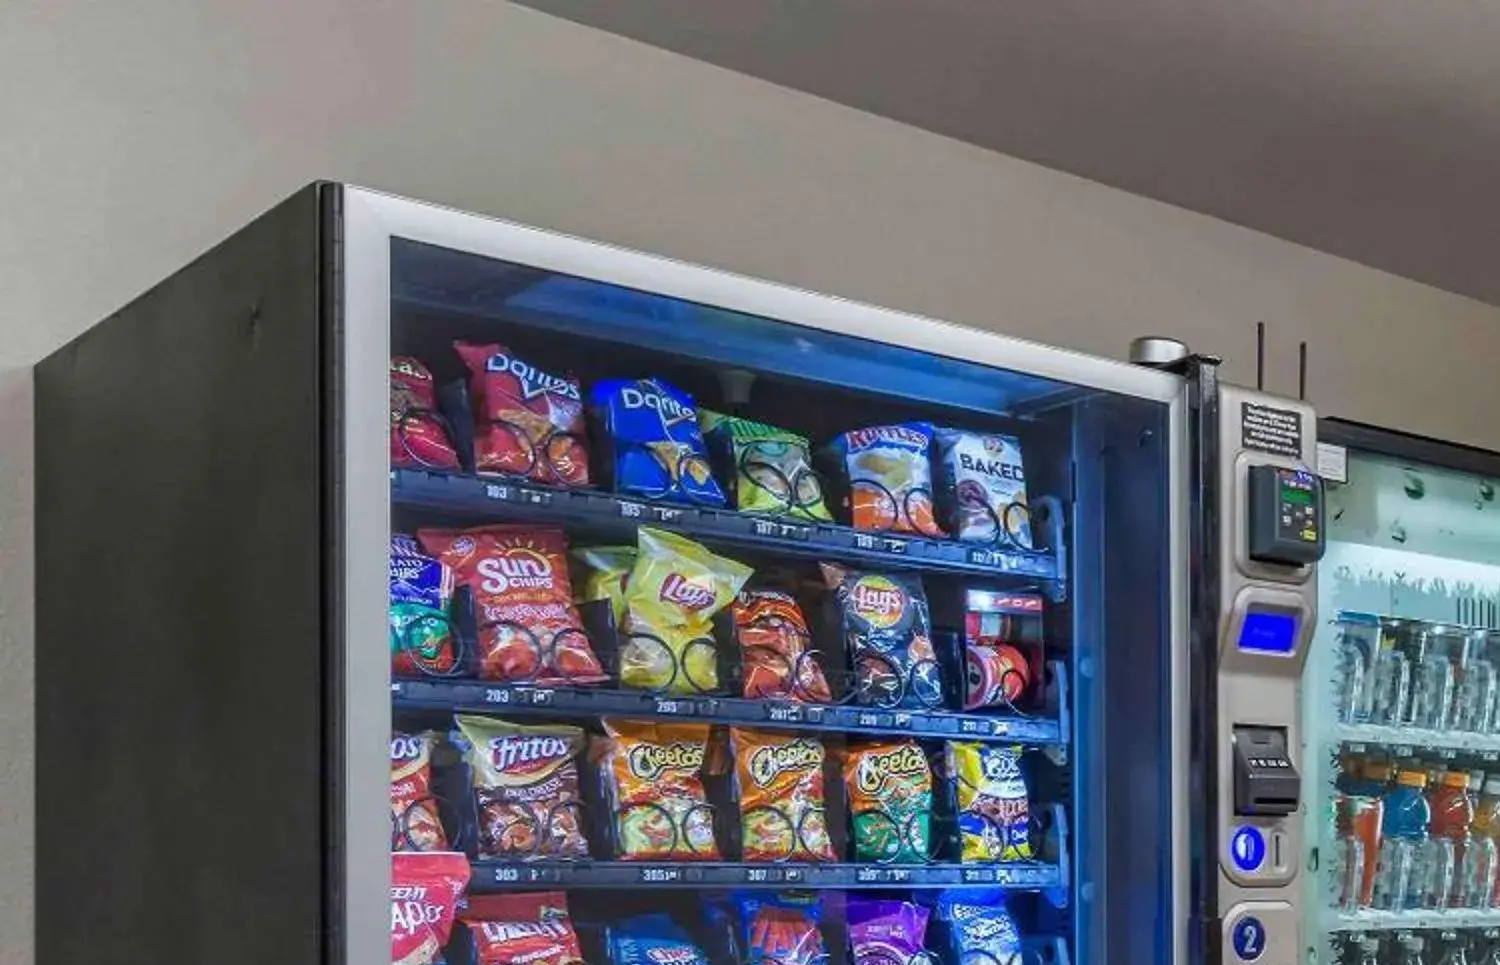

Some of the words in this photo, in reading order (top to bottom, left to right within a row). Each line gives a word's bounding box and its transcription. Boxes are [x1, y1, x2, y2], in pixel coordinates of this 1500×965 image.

[477, 557, 552, 594] Sun
[509, 577, 553, 588] CHIPS
[486, 689, 509, 702] 203
[489, 735, 569, 771] Fritos
[495, 869, 518, 881] 303
[1243, 925, 1257, 953] 2
